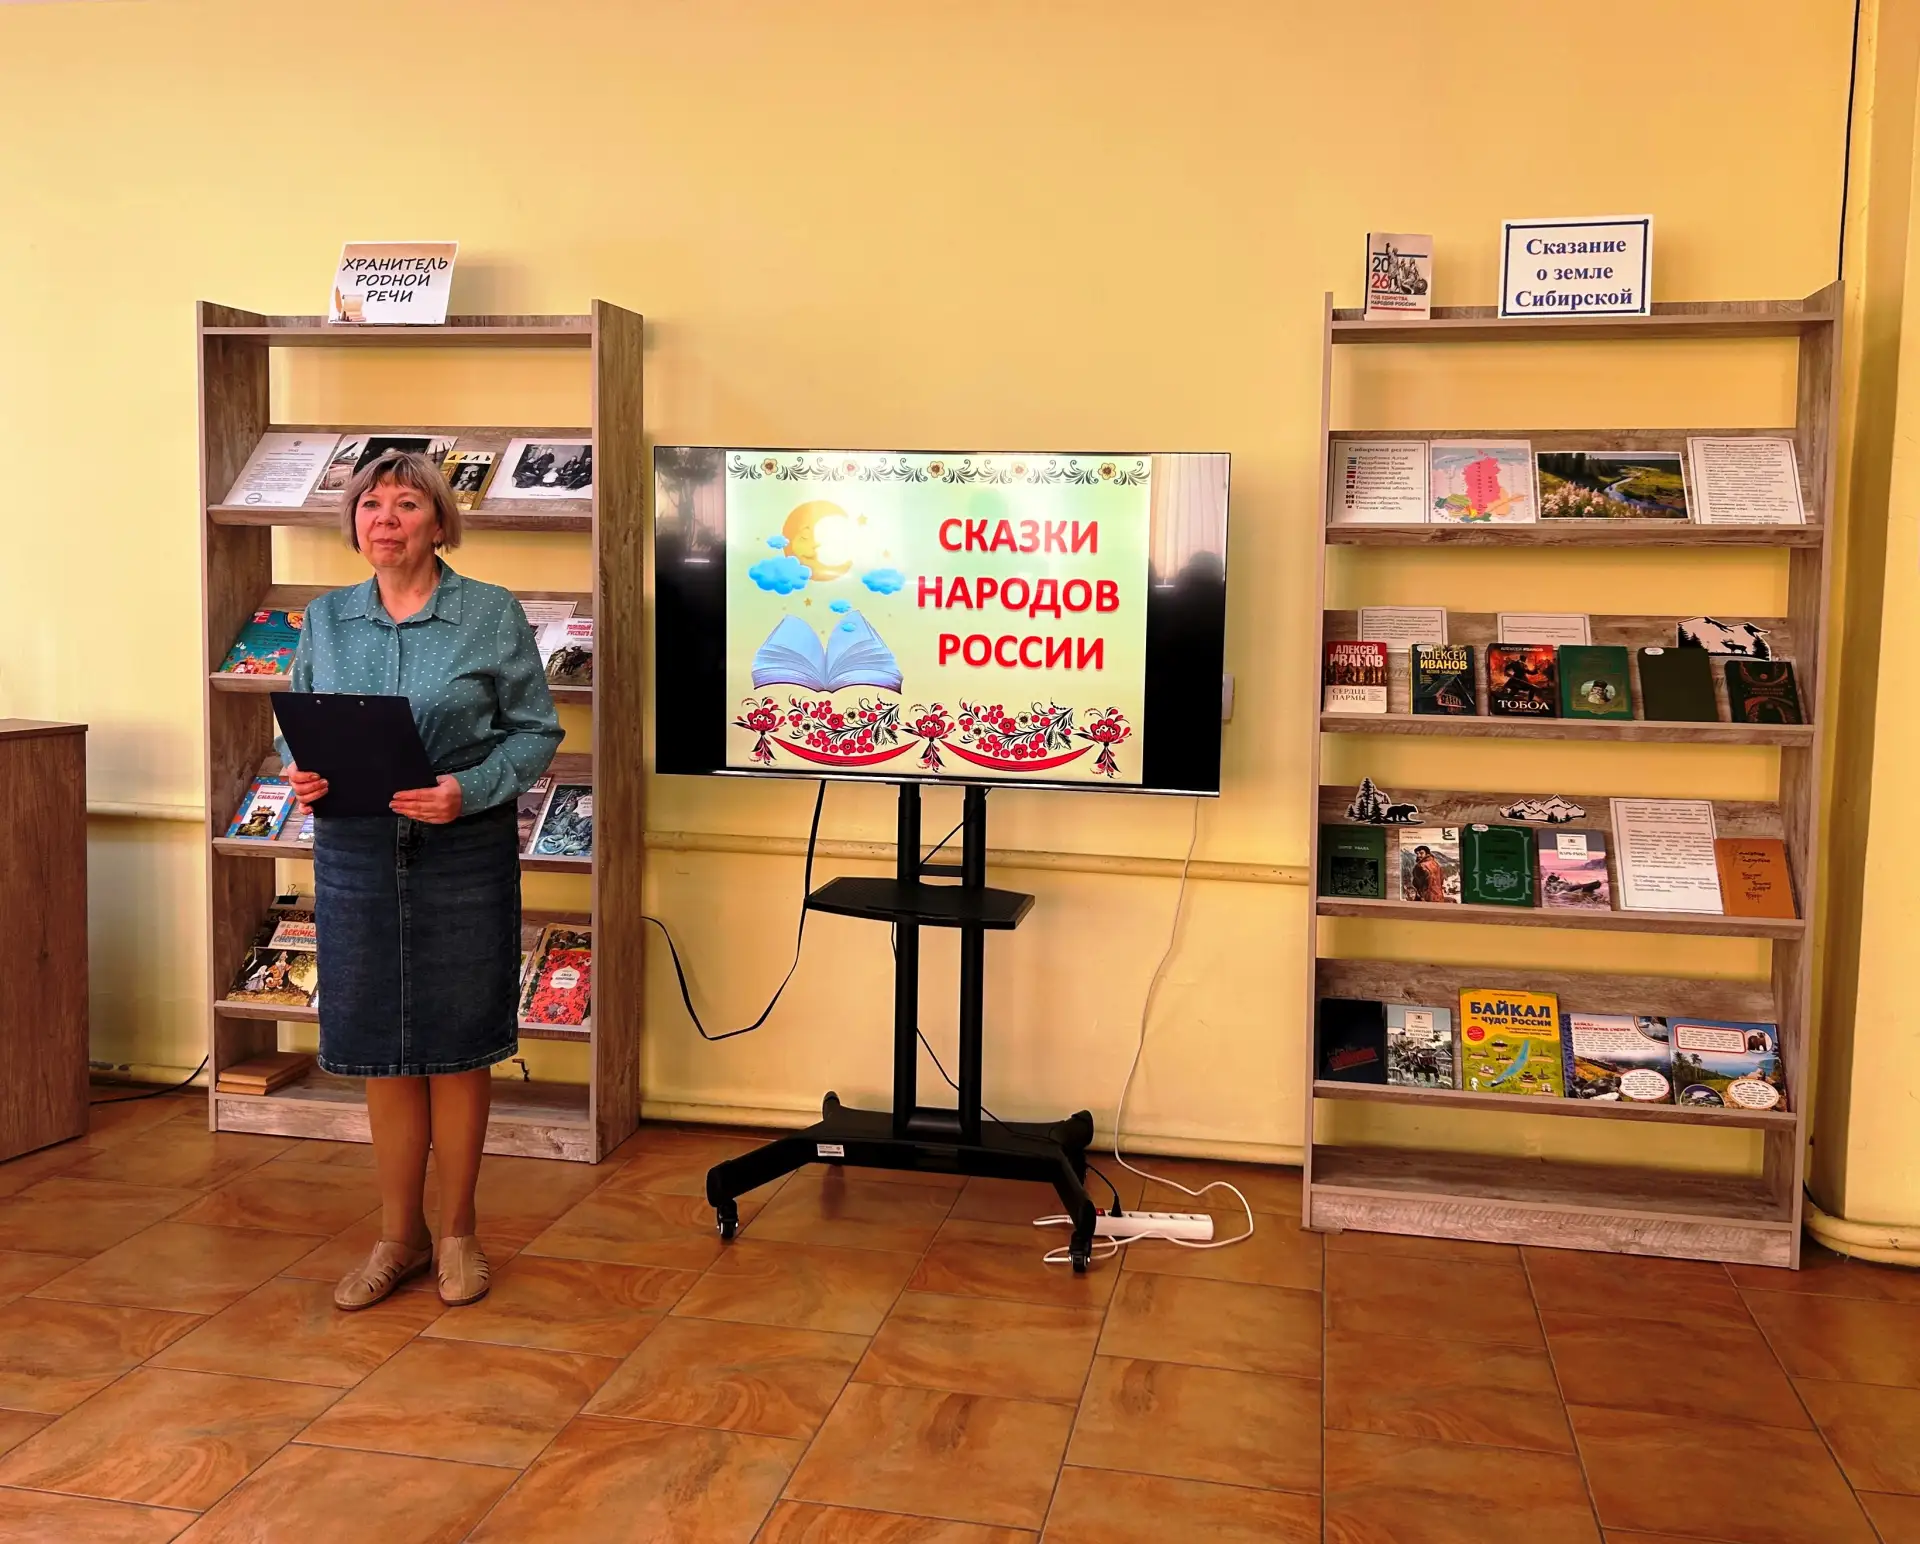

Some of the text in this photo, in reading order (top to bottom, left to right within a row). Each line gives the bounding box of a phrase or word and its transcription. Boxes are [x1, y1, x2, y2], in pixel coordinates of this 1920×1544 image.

[1526, 239, 1627, 255] Сказание
[342, 257, 448, 271] ХРАНИТЕЛЬ
[1372, 257, 1390, 273] 20
[355, 270, 431, 286] РОДНОЙ
[1371, 273, 1390, 289] 26
[1536, 266, 1614, 280] о земле
[366, 290, 413, 302] РЕЧИ
[1515, 288, 1633, 310] Сибирской
[938, 518, 1099, 554] СКАЗКИ
[917, 575, 1120, 619] НАРОДОВ
[938, 633, 1104, 670] РОССИИ
[1336, 644, 1378, 655] АЛЕКСЕЙ
[1420, 650, 1467, 660] АЛЕКСЕЙ
[1330, 654, 1384, 667] ИВАНОВ
[1420, 660, 1468, 670] ИВАНОВ
[1497, 699, 1550, 710] ТОБОЛ
[1470, 1000, 1551, 1018] БАЙКАЛ
